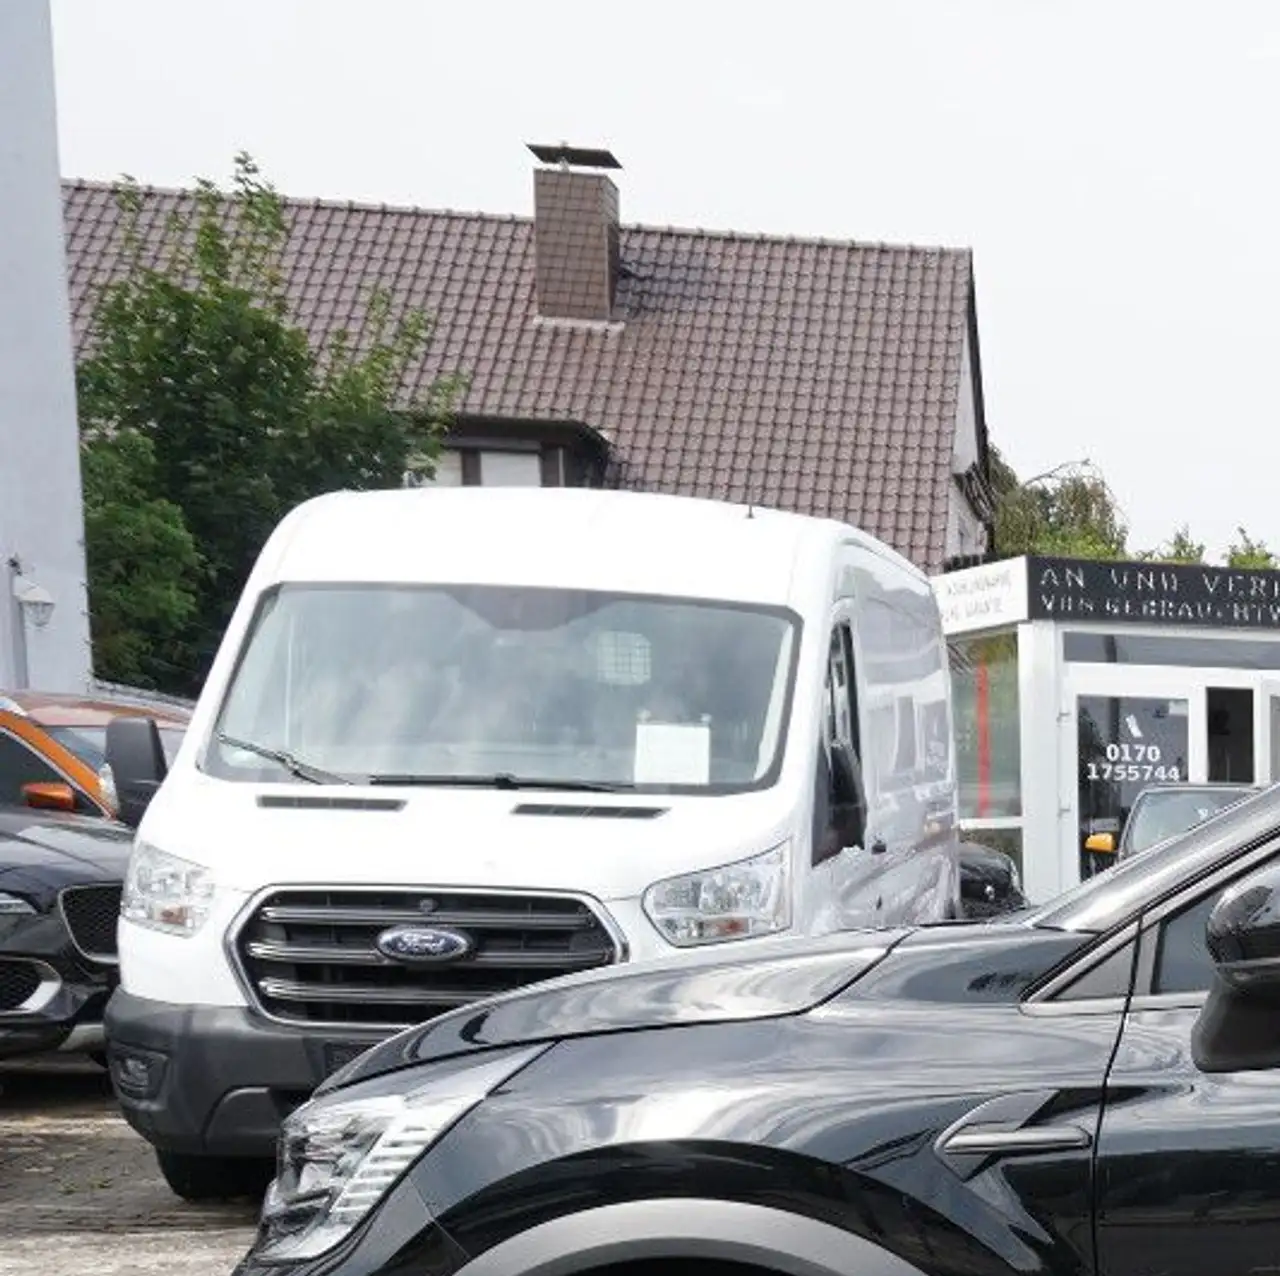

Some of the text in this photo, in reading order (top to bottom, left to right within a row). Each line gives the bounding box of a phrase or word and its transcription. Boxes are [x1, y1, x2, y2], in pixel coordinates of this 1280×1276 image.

[1040, 567, 1085, 588] AN
[1105, 743, 1161, 762] 0170
[1086, 762, 1180, 782] 1755744
